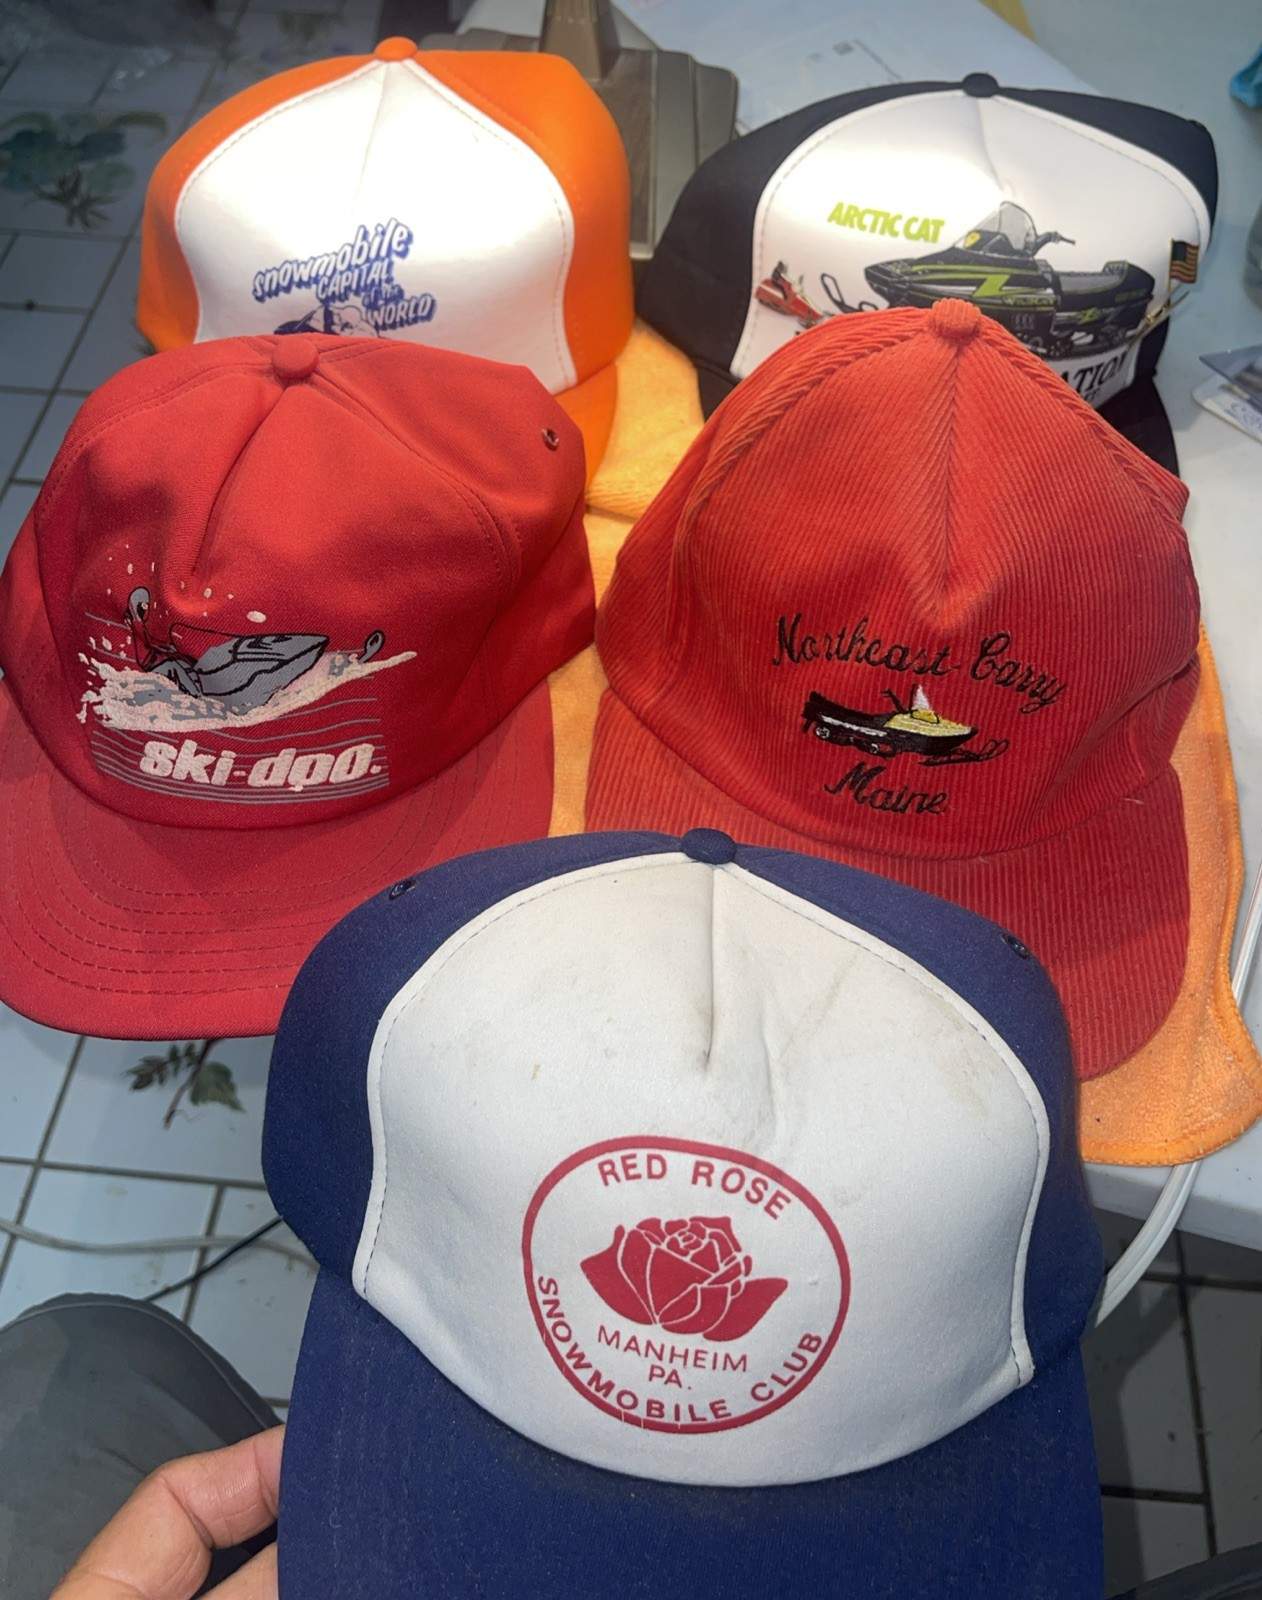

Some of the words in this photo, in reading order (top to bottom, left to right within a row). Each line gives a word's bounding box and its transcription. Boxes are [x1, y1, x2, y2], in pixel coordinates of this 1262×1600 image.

[827, 202, 902, 238] ARCTIC
[903, 216, 945, 243] CAT
[316, 257, 394, 303] CAPITAL
[365, 292, 436, 331] WORLD
[772, 613, 960, 676] Northeast
[970, 630, 1068, 715] Carry
[824, 761, 948, 815] Maine
[598, 1152, 668, 1187] RED
[690, 1160, 792, 1221] ROSE
[537, 1275, 732, 1422] SNOWMOBILE
[750, 1332, 823, 1403] CLUB
[597, 1324, 748, 1373] MANHEIM
[648, 1363, 692, 1391] PA.
